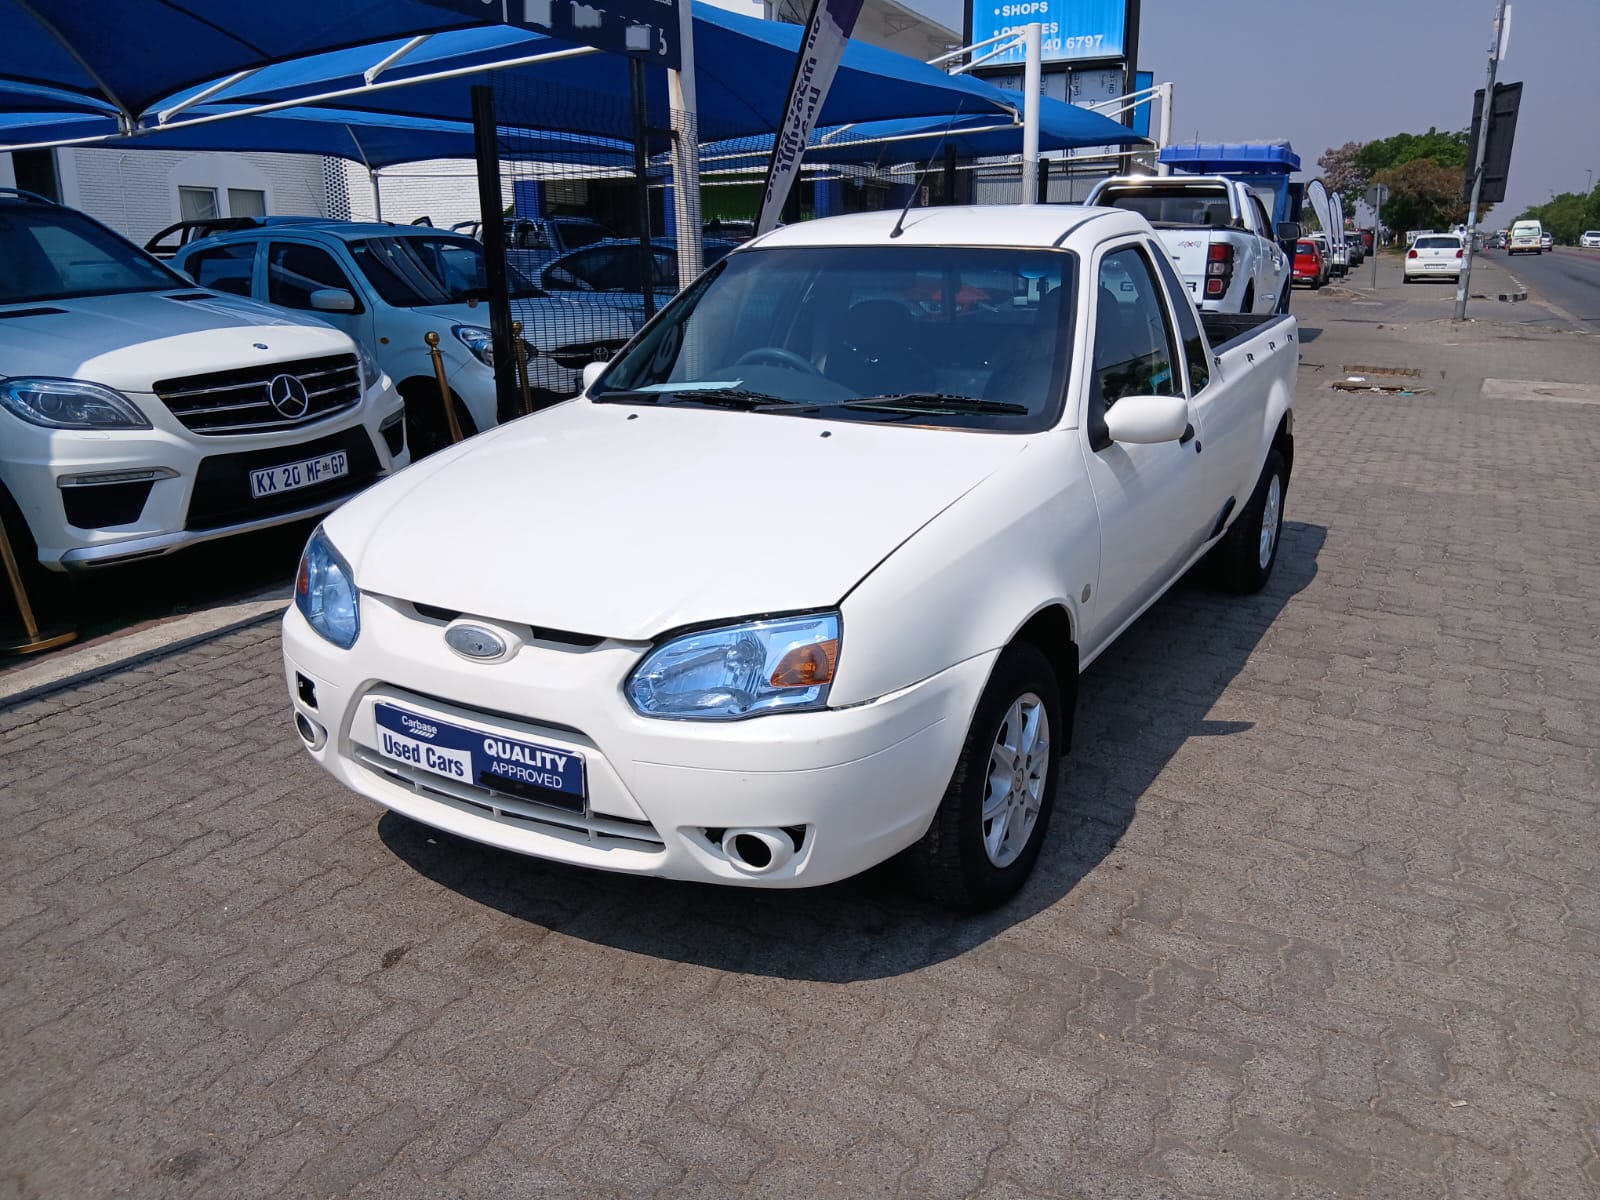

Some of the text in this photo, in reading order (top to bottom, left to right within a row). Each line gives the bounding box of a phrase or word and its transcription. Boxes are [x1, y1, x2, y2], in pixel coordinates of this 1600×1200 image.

[1002, 1, 1048, 16] SHOPS
[1066, 34, 1104, 49] 6797
[256, 454, 345, 493] KX 20 MF GP
[401, 715, 438, 734] Carbase
[382, 732, 464, 777] Used Cars
[483, 738, 568, 773] QUALITY
[491, 760, 563, 789] APPROVED
